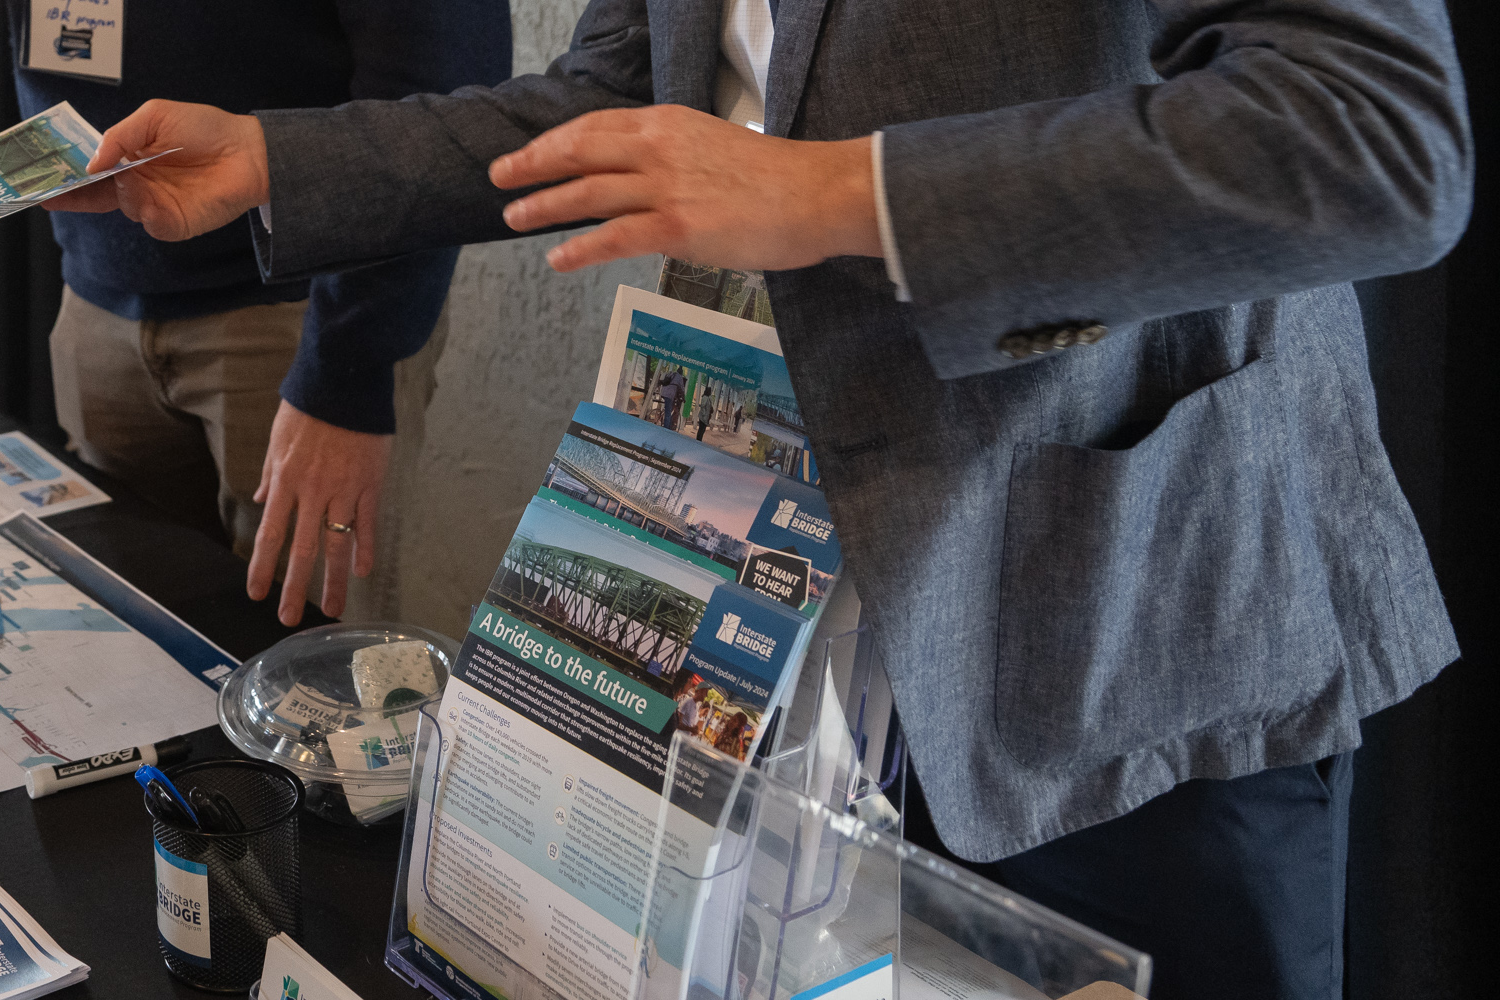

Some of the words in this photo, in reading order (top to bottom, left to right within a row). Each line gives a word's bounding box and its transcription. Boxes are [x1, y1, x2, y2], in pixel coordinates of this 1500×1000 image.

[630, 338, 654, 350] Interstate
[654, 345, 671, 356] Bridge
[671, 351, 705, 367] Replacement
[705, 363, 727, 375] program
[580, 429, 597, 439] Interstate
[596, 436, 609, 444] Bridge
[608, 440, 632, 453] Replacement
[632, 450, 648, 460] Program
[650, 457, 671, 469] September
[670, 465, 681, 473] 2024
[791, 517, 830, 540] BRIDGE
[795, 510, 833, 530] Interstate
[753, 573, 766, 586] TO
[765, 579, 792, 598] HEAR
[756, 559, 772, 574] WE
[771, 566, 801, 586] WANT
[735, 633, 773, 657] BRIDGE
[738, 624, 776, 647] Interstate
[479, 612, 492, 632] A
[492, 617, 542, 658] bridge
[544, 646, 562, 668] to
[564, 656, 592, 684] the
[593, 670, 646, 714] future
[688, 653, 714, 671] Program
[714, 666, 736, 682] Update
[739, 679, 753, 692] July
[752, 685, 768, 697] 2024
[457, 691, 479, 709] Current
[479, 704, 510, 728] Challenges
[465, 669, 478, 681] keeps
[477, 678, 493, 689] people
[492, 686, 502, 694] and
[501, 691, 510, 699] our
[510, 696, 530, 712] economy
[530, 708, 548, 722] moving
[547, 716, 557, 726] into
[557, 722, 566, 731] the
[566, 726, 581, 740] future.
[472, 653, 486, 664] across
[486, 660, 494, 668] the
[494, 664, 515, 680] Columbia
[514, 676, 527, 686] River
[526, 684, 536, 692] and
[535, 689, 553, 701] related
[552, 697, 580, 717] interchange
[580, 713, 615, 736] improvements
[615, 733, 631, 745] within
[631, 741, 640, 750] the
[640, 746, 663, 763] five-mile
[476, 643, 485, 653] The
[484, 649, 493, 657] IBR
[492, 654, 511, 667] program
[518, 667, 530, 678] joint
[529, 674, 543, 685] effort
[542, 680, 563, 696] between
[562, 692, 580, 705] Oregon
[580, 702, 590, 711] and
[590, 706, 618, 726] Washington
[618, 722, 624, 730] to
[624, 726, 643, 740] replace
[643, 736, 652, 745] the
[652, 742, 667, 755] aging
[478, 667, 493, 678] ensure
[496, 677, 514, 692] modern,
[515, 688, 542, 706] multimodal
[541, 703, 560, 716] corridor
[560, 713, 570, 722] that
[570, 719, 598, 738] strengthens
[598, 735, 627, 754] earthquake
[578, 777, 598, 793] Impaired
[598, 788, 613, 802] freight
[613, 799, 639, 817] movement:
[457, 829, 492, 857] Investments
[571, 805, 595, 824] Inadequate
[595, 820, 611, 834] bicycle
[611, 831, 621, 840] and
[620, 837, 645, 854] pedestrian
[562, 842, 579, 856] Limited
[579, 853, 593, 865] public
[593, 862, 627, 887] transportation:
[159, 890, 201, 925] BRIDGE
